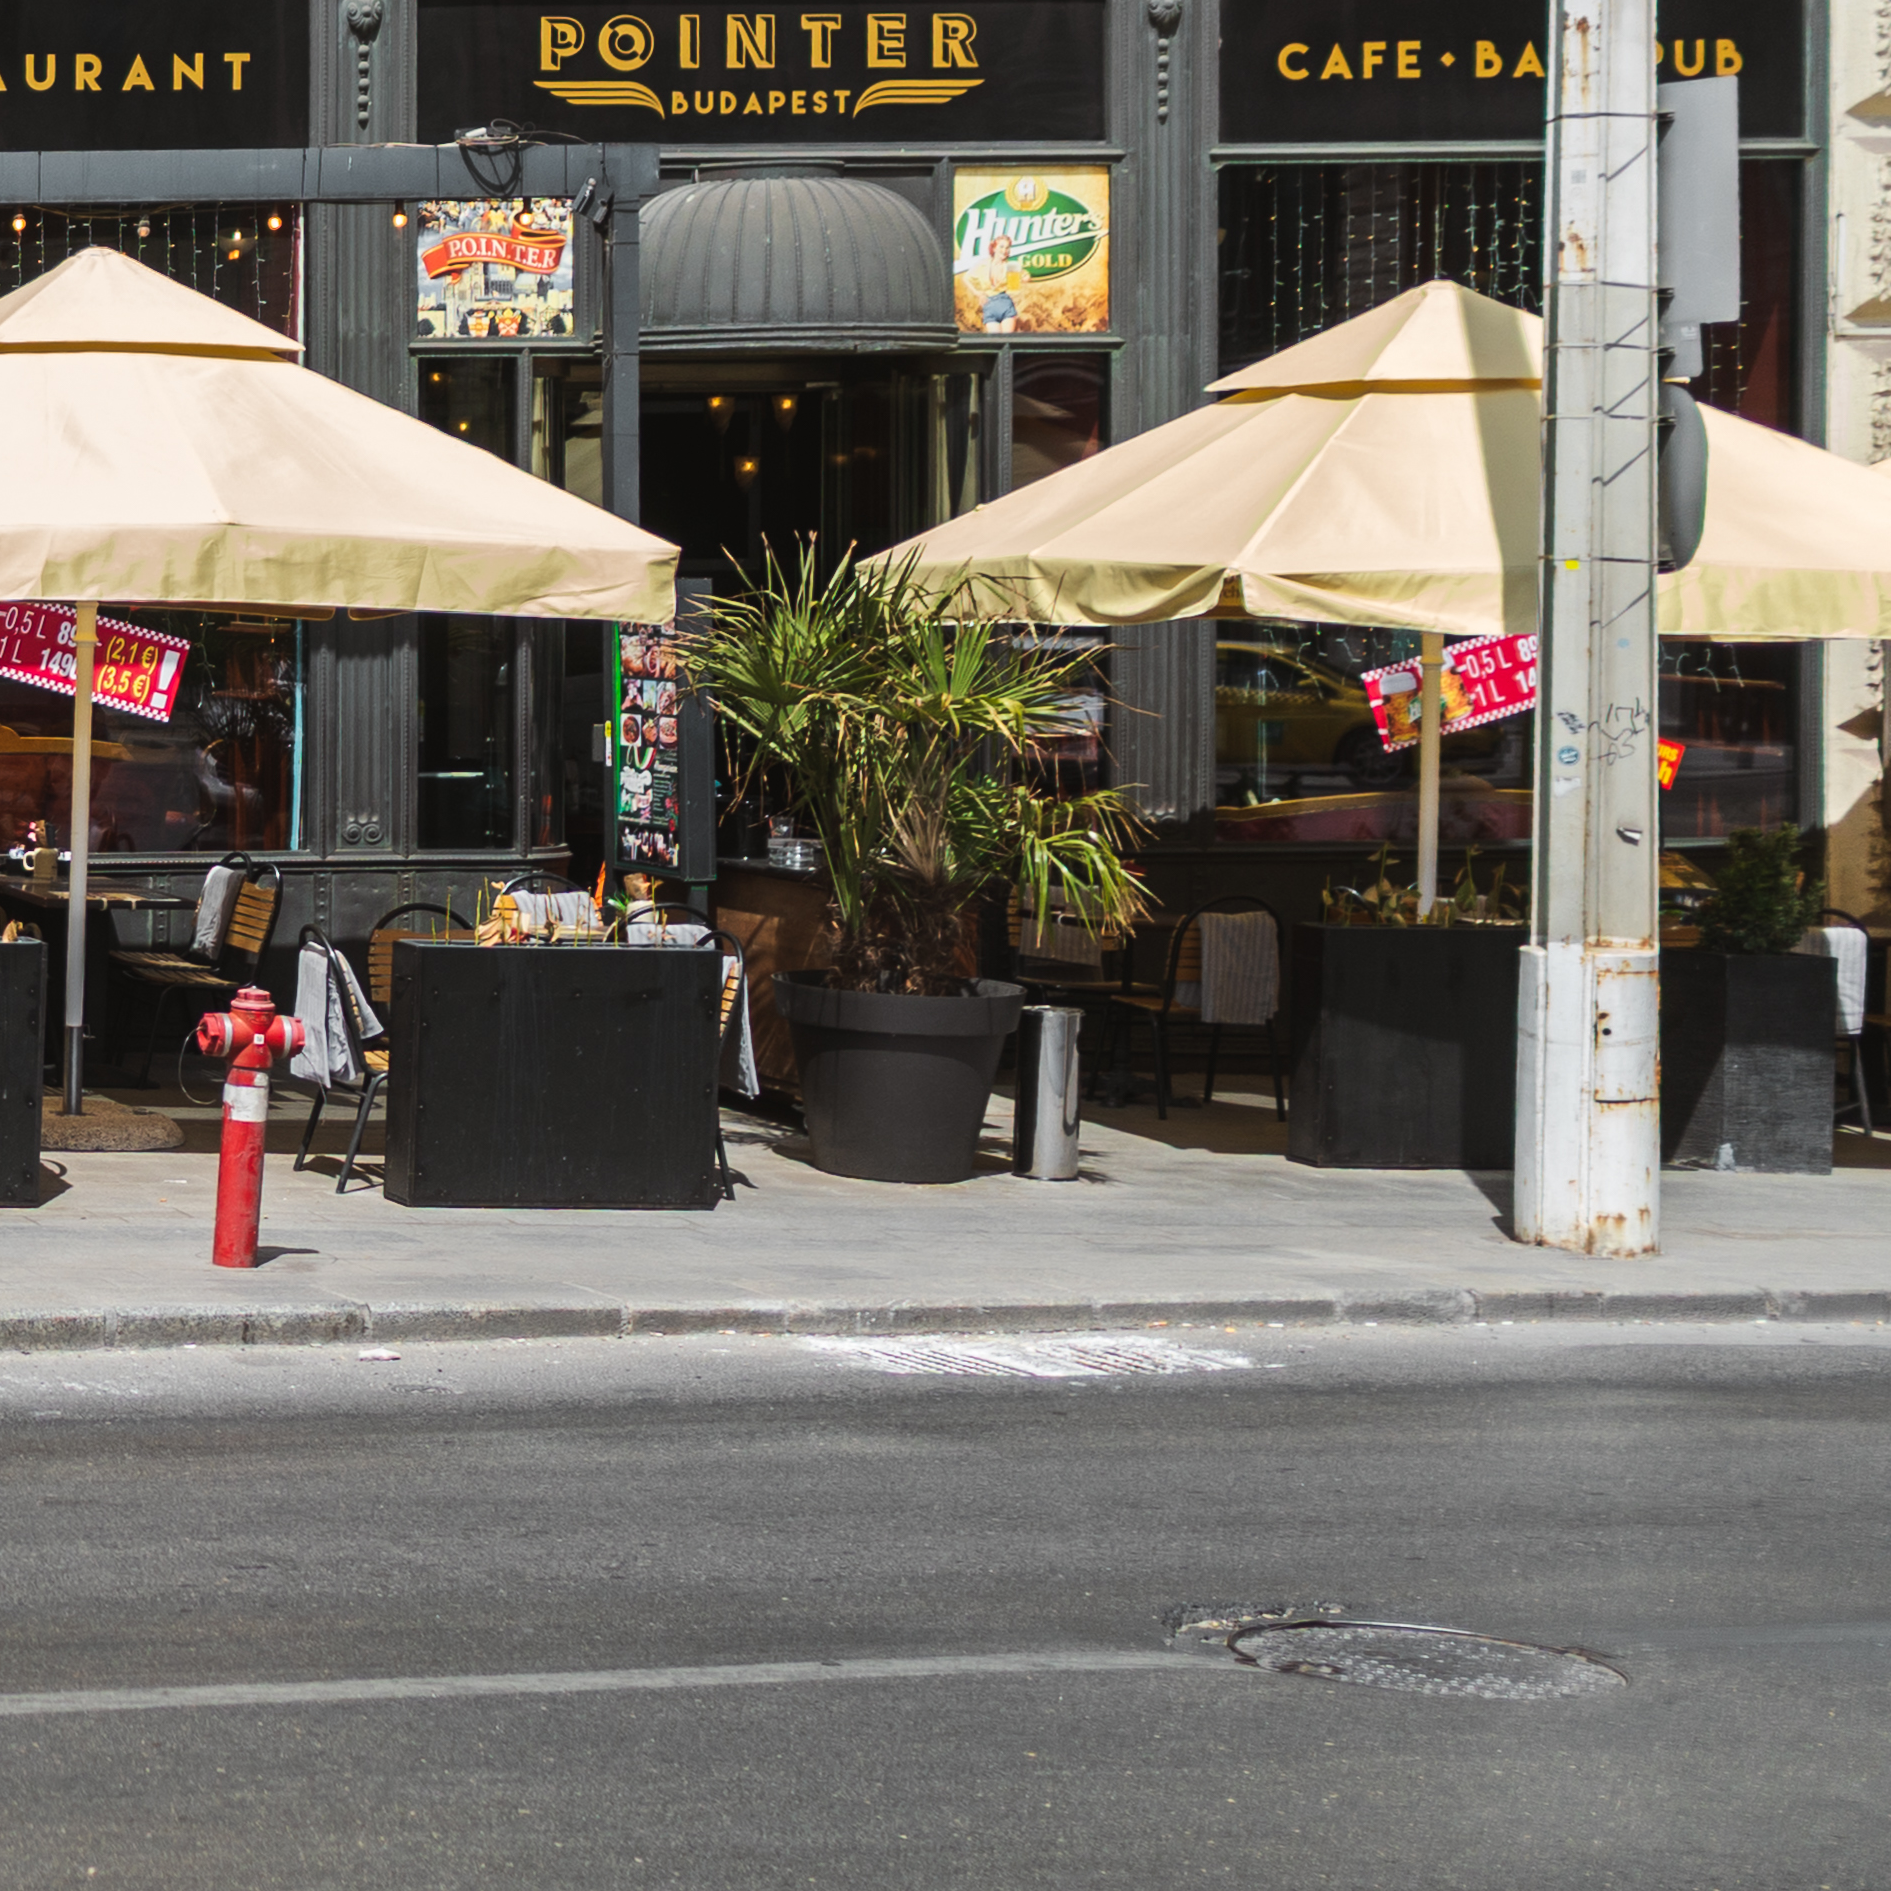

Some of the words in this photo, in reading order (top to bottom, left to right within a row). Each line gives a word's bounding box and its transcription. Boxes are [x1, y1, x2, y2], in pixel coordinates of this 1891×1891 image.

[540, 12, 979, 72] POINTER
[1277, 40, 1422, 81] CAFE
[1475, 39, 1546, 79] BA
[671, 89, 851, 115] BUDAPEST
[1019, 253, 1073, 268] GOLD
[36, 614, 46, 639] L
[11, 639, 22, 664] L
[1496, 645, 1512, 669] L
[1489, 679, 1506, 703] L
